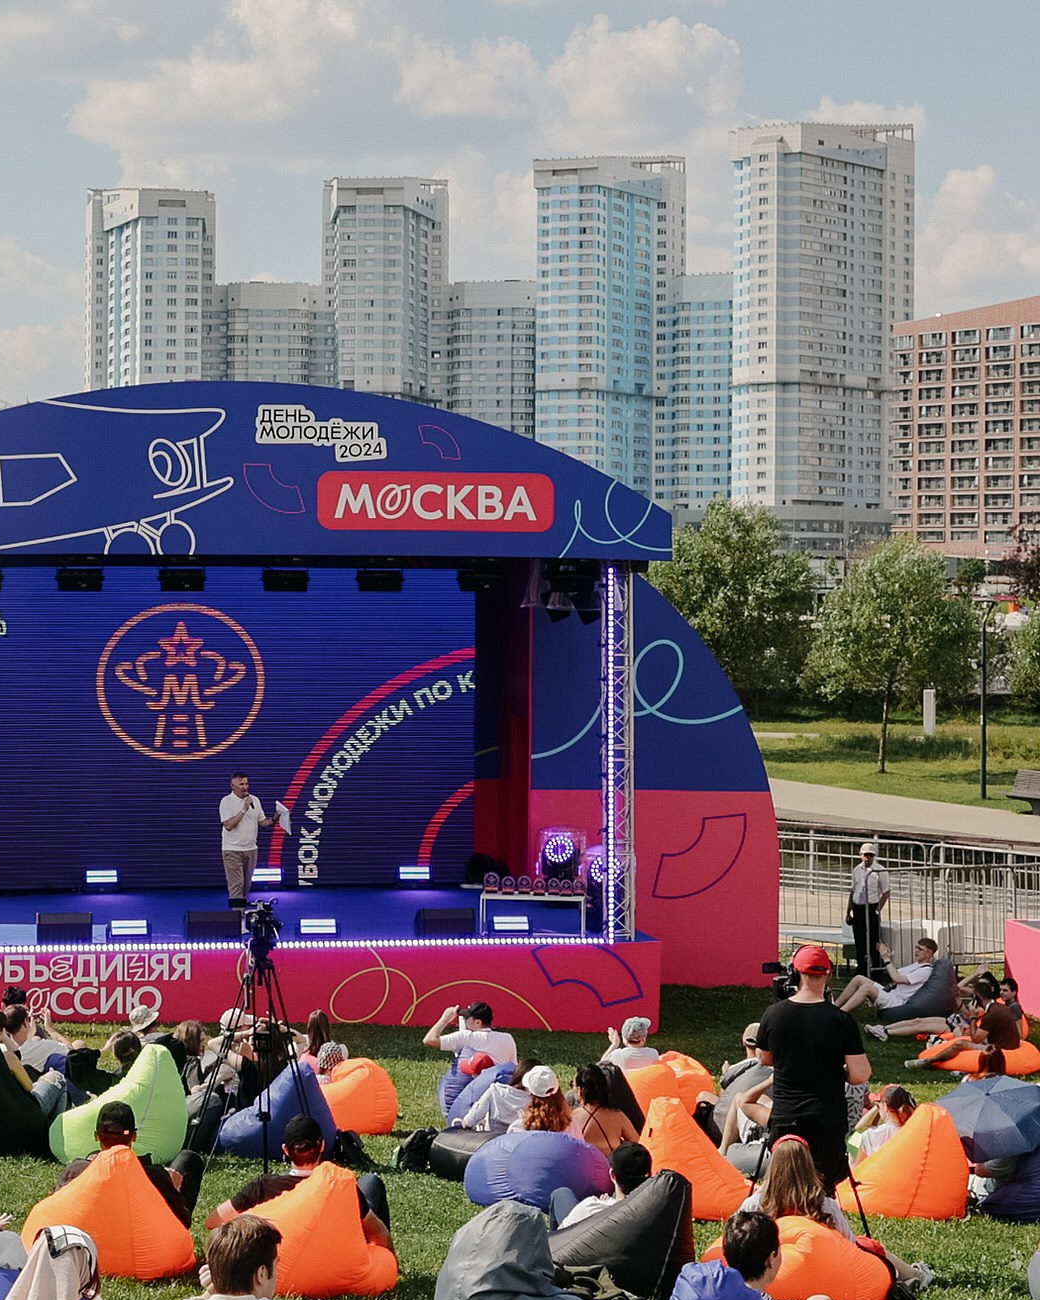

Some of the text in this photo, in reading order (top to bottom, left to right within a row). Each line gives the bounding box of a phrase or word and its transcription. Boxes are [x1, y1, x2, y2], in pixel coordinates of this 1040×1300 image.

[260, 408, 311, 425] ДЕНЬ
[260, 421, 375, 442] МОЛОДЁЖИ
[339, 442, 384, 458] 2024
[334, 483, 537, 522] МОСКВА
[413, 680, 454, 709] ПО
[26, 985, 163, 1016] ОССИЮ
